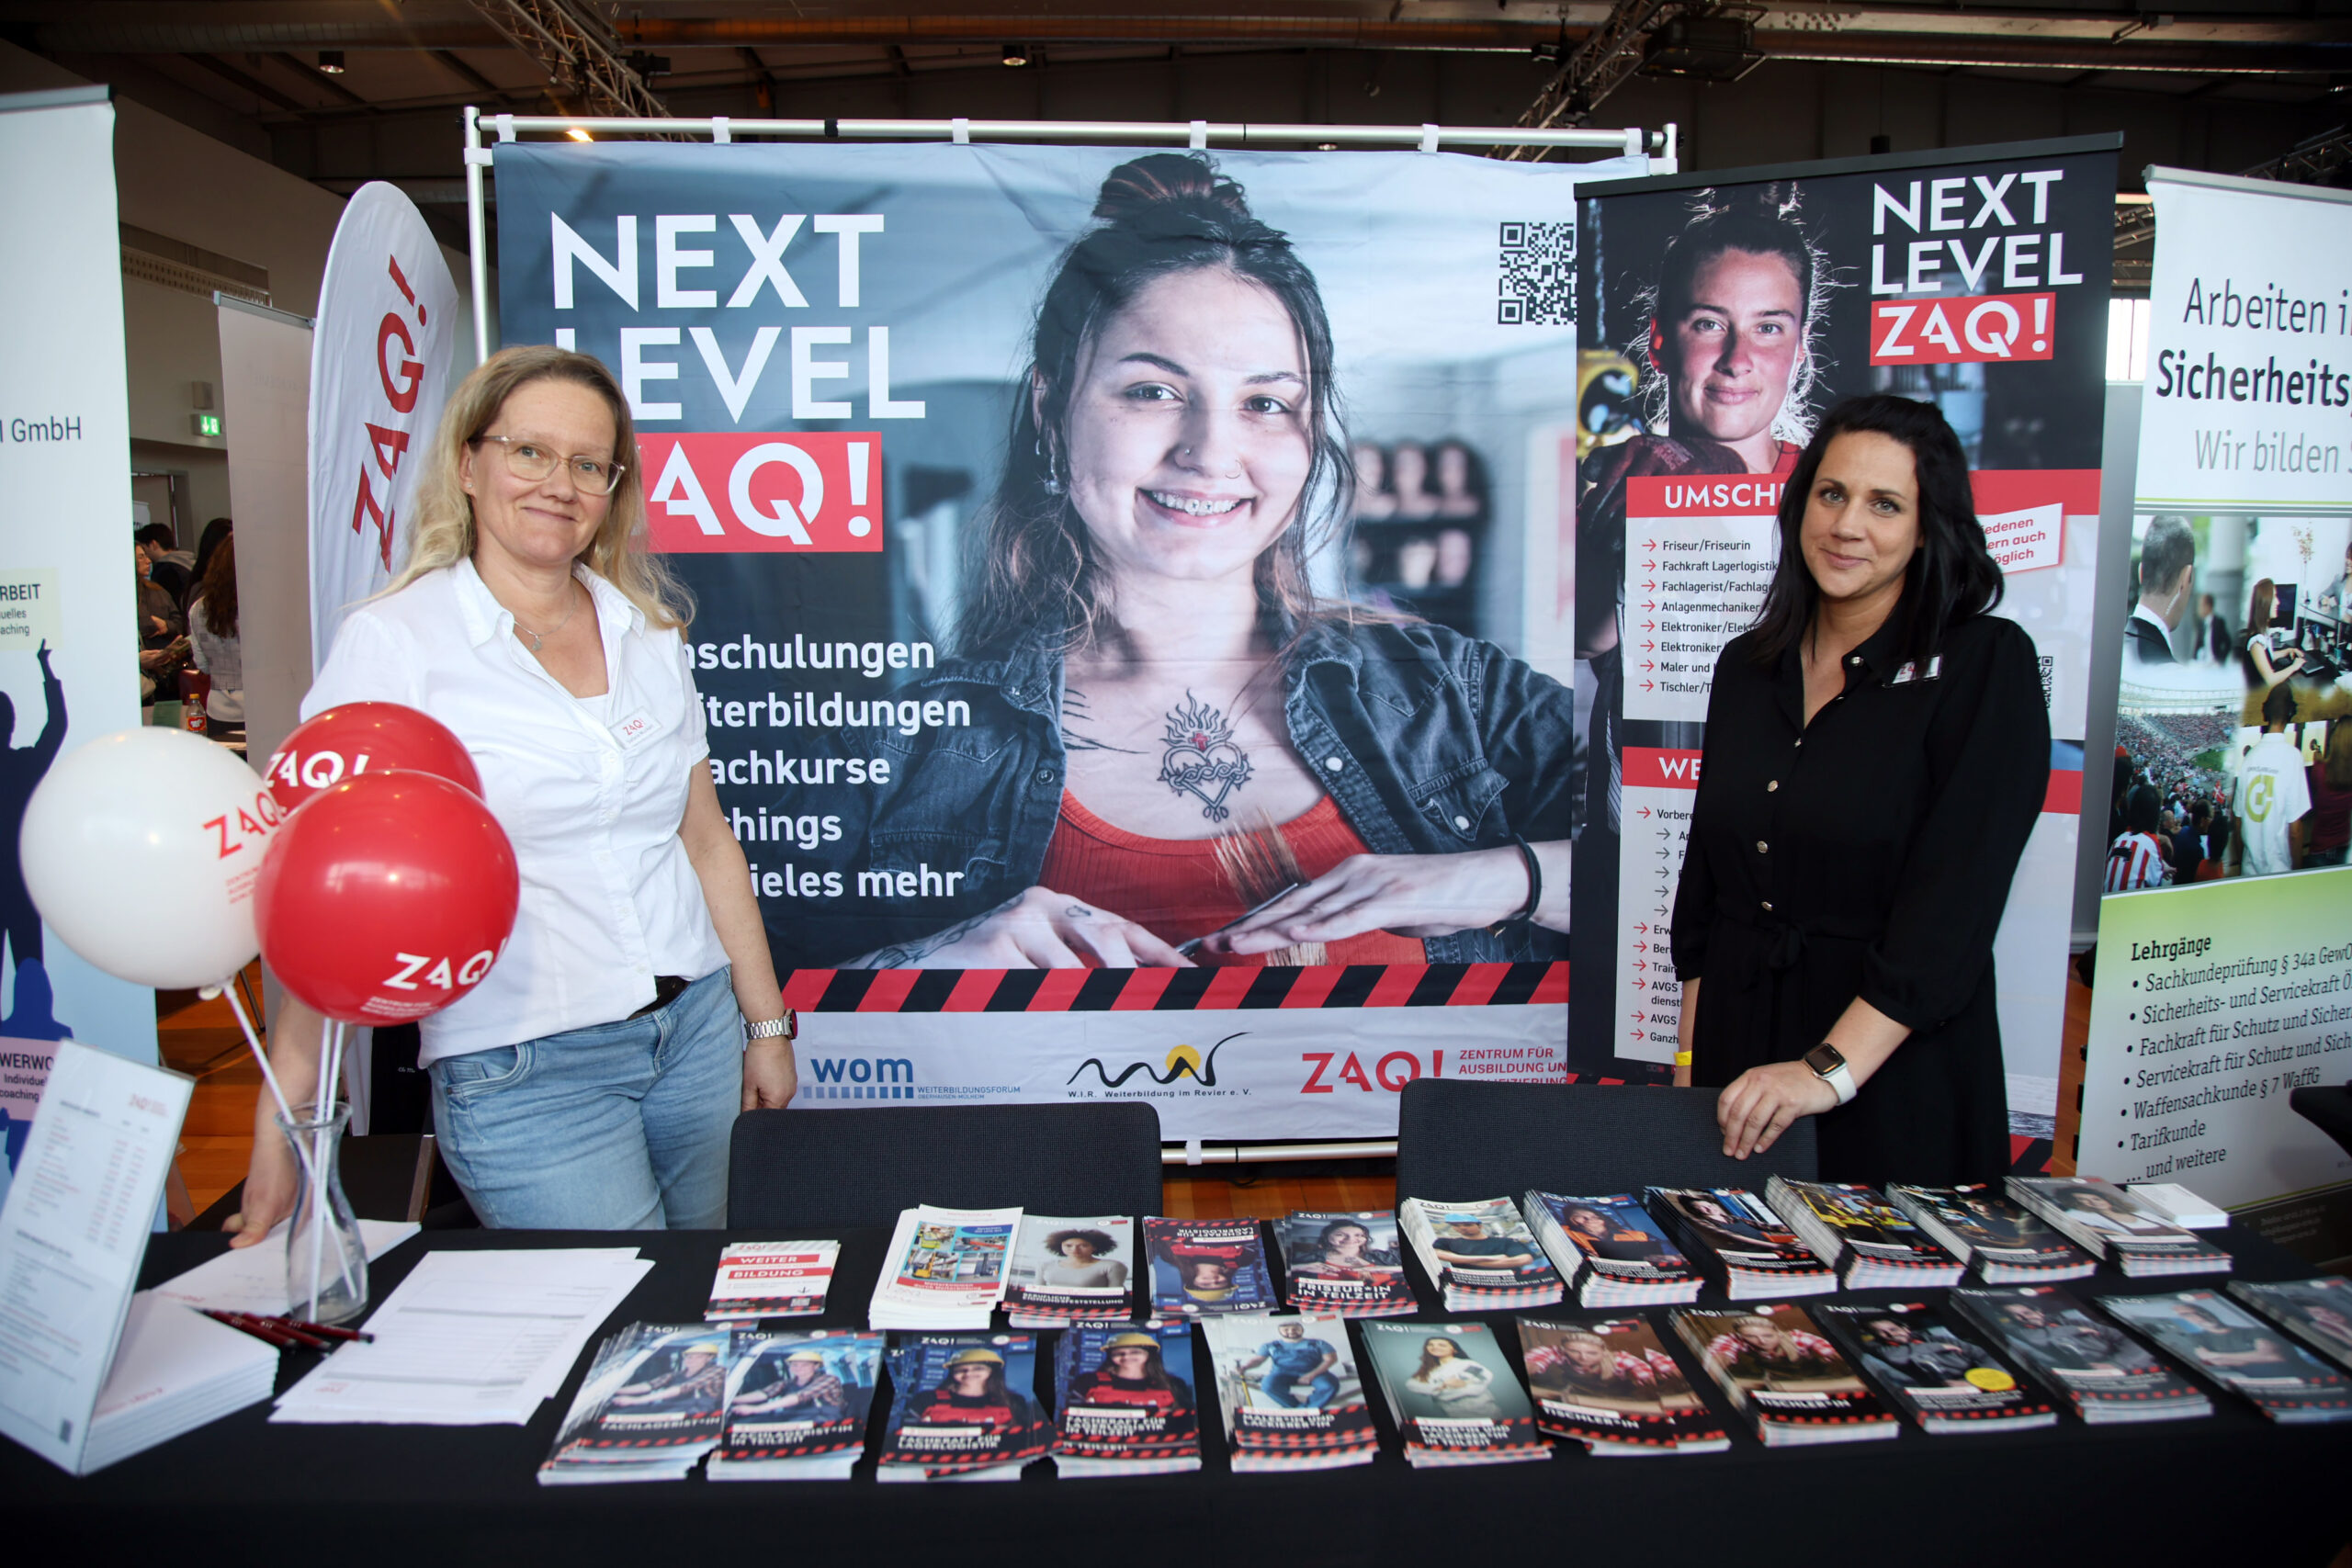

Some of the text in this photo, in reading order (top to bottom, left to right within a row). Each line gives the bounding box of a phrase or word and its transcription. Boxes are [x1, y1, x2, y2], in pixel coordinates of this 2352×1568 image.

[1871, 169, 2064, 236] NEXT
[551, 212, 885, 312] NEXT
[1871, 232, 2084, 296] LEVEL
[2183, 277, 2327, 334] Arbeiten
[1874, 298, 2050, 358] ZAQ!
[555, 326, 926, 423] EVEL
[2156, 349, 2350, 407] Sicherheits
[353, 254, 427, 571] ZAQ!
[12, 416, 82, 443] GmbH
[2195, 428, 2339, 473] Wir bilden
[647, 440, 871, 545] AQ!
[1662, 538, 1751, 552] Friseur/Friseurin
[2012, 530, 2046, 546] auch
[1662, 560, 1779, 574] Fachkraft Lagerlogistik
[0, 583, 41, 602] RBEIT
[1660, 661, 1711, 673] Maler und
[695, 692, 971, 736] terbildungen
[725, 807, 842, 851] hings
[858, 863, 965, 897] mehr
[2131, 936, 2211, 962] Lehrgänge
[2144, 956, 2278, 992] Sachkundeprüfung
[2281, 955, 2289, 975] §
[2292, 952, 2316, 972] 34a
[1651, 980, 1679, 993] AVGS
[2142, 995, 2226, 1025] Sicherheits-
[2229, 986, 2257, 1010] und
[2259, 976, 2340, 1005] Servicekraft
[1650, 1013, 1677, 1026] AVGS
[2139, 1026, 2207, 1057] Fachkraft
[2209, 1022, 2230, 1044] für
[2233, 1019, 2280, 1041] Schutz
[2282, 1006, 2308, 1029] und
[1460, 1046, 1554, 1060] ZENTRUM FÜR
[2136, 1057, 2222, 1089] Servicekraft
[2223, 1051, 2245, 1072] für
[2247, 1045, 2293, 1068] Schutz
[2296, 1034, 2321, 1059] und
[810, 1058, 914, 1083] wom
[1300, 1050, 1444, 1093] ZAQ!
[1458, 1063, 1538, 1075] AUSBILDUNG
[918, 1086, 1022, 1094] WEITERBILDUNGSFORUM
[1068, 1090, 1097, 1099] W.I.R.
[1104, 1089, 1175, 1099] Weiterbildung
[1194, 1089, 1227, 1097] Revier
[2133, 1066, 2321, 1120] Waffensachkunde § 7 WaffG
[2130, 1119, 2207, 1152] Tarifkunde
[2145, 1154, 2172, 1179] und
[2175, 1147, 2227, 1172] weitere
[740, 1255, 797, 1264] WEITER
[733, 1269, 804, 1278] BILDUNG
[1298, 1288, 1389, 1300] IN TEILZEIT
[645, 1325, 679, 1334] ZAQ!
[739, 1332, 773, 1340] ZAQ!
[1076, 1321, 1109, 1329] ZAQ!
[1376, 1323, 1409, 1333] ZAQ!
[922, 1337, 955, 1345] ZAQ!
